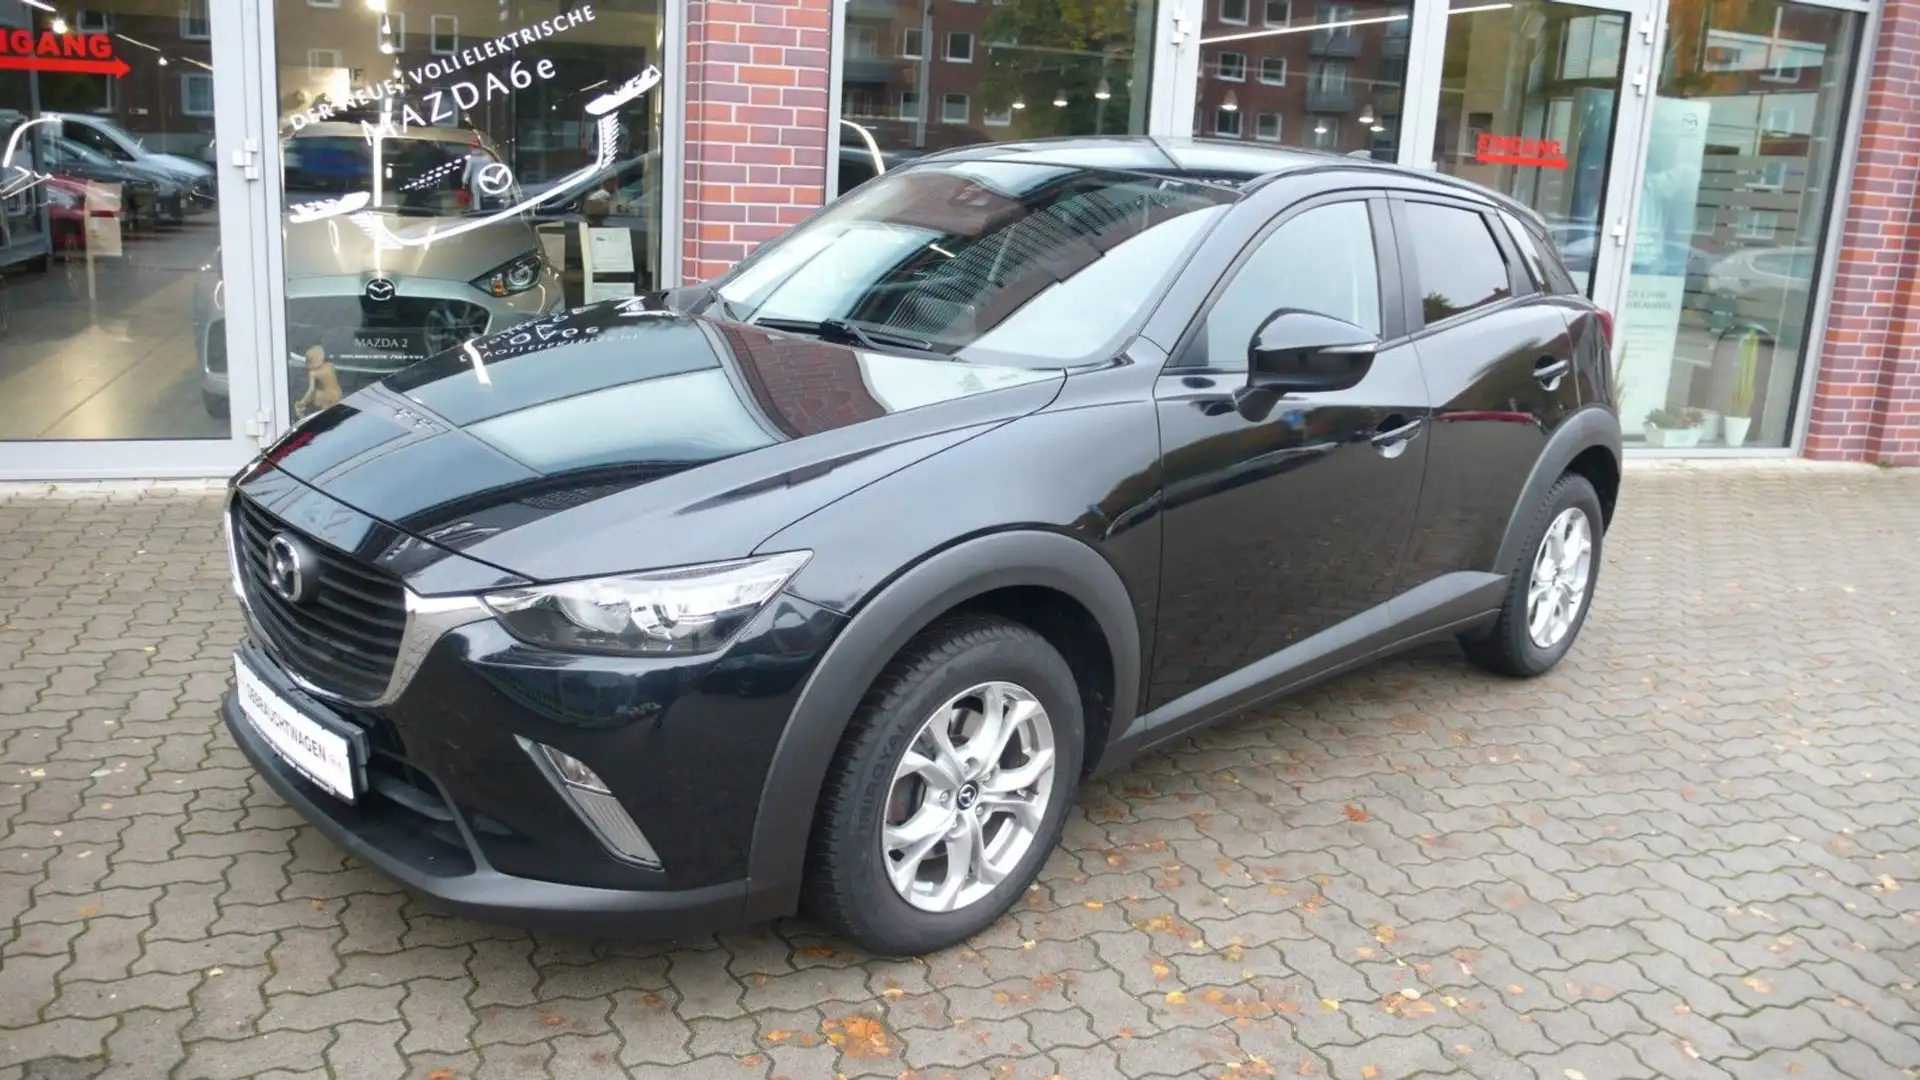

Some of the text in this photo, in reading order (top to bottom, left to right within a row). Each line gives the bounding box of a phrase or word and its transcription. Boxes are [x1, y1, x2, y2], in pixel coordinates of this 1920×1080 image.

[361, 57, 557, 147] MAZDA6e
[1477, 134, 1561, 156] EINGANG
[354, 338, 409, 348] MAZDA 2
